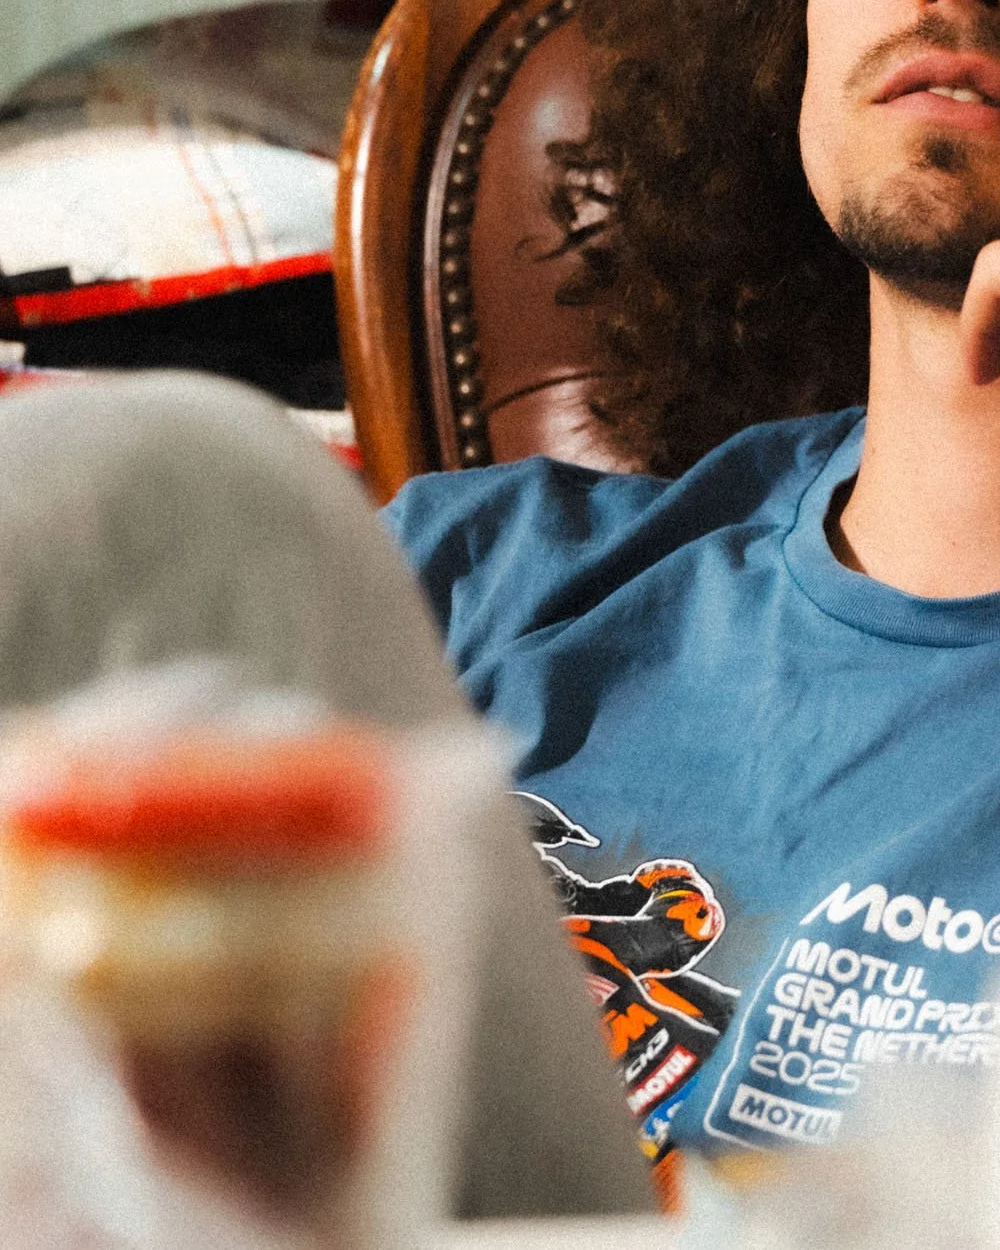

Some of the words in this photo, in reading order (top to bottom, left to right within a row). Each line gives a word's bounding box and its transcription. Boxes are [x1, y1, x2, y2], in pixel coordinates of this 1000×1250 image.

[785, 937, 928, 999] MOTUL
[774, 972, 915, 1031] GRAND
[765, 1004, 853, 1060] THE
[626, 1050, 695, 1114] MOTUL
[750, 1040, 866, 1096] 2025
